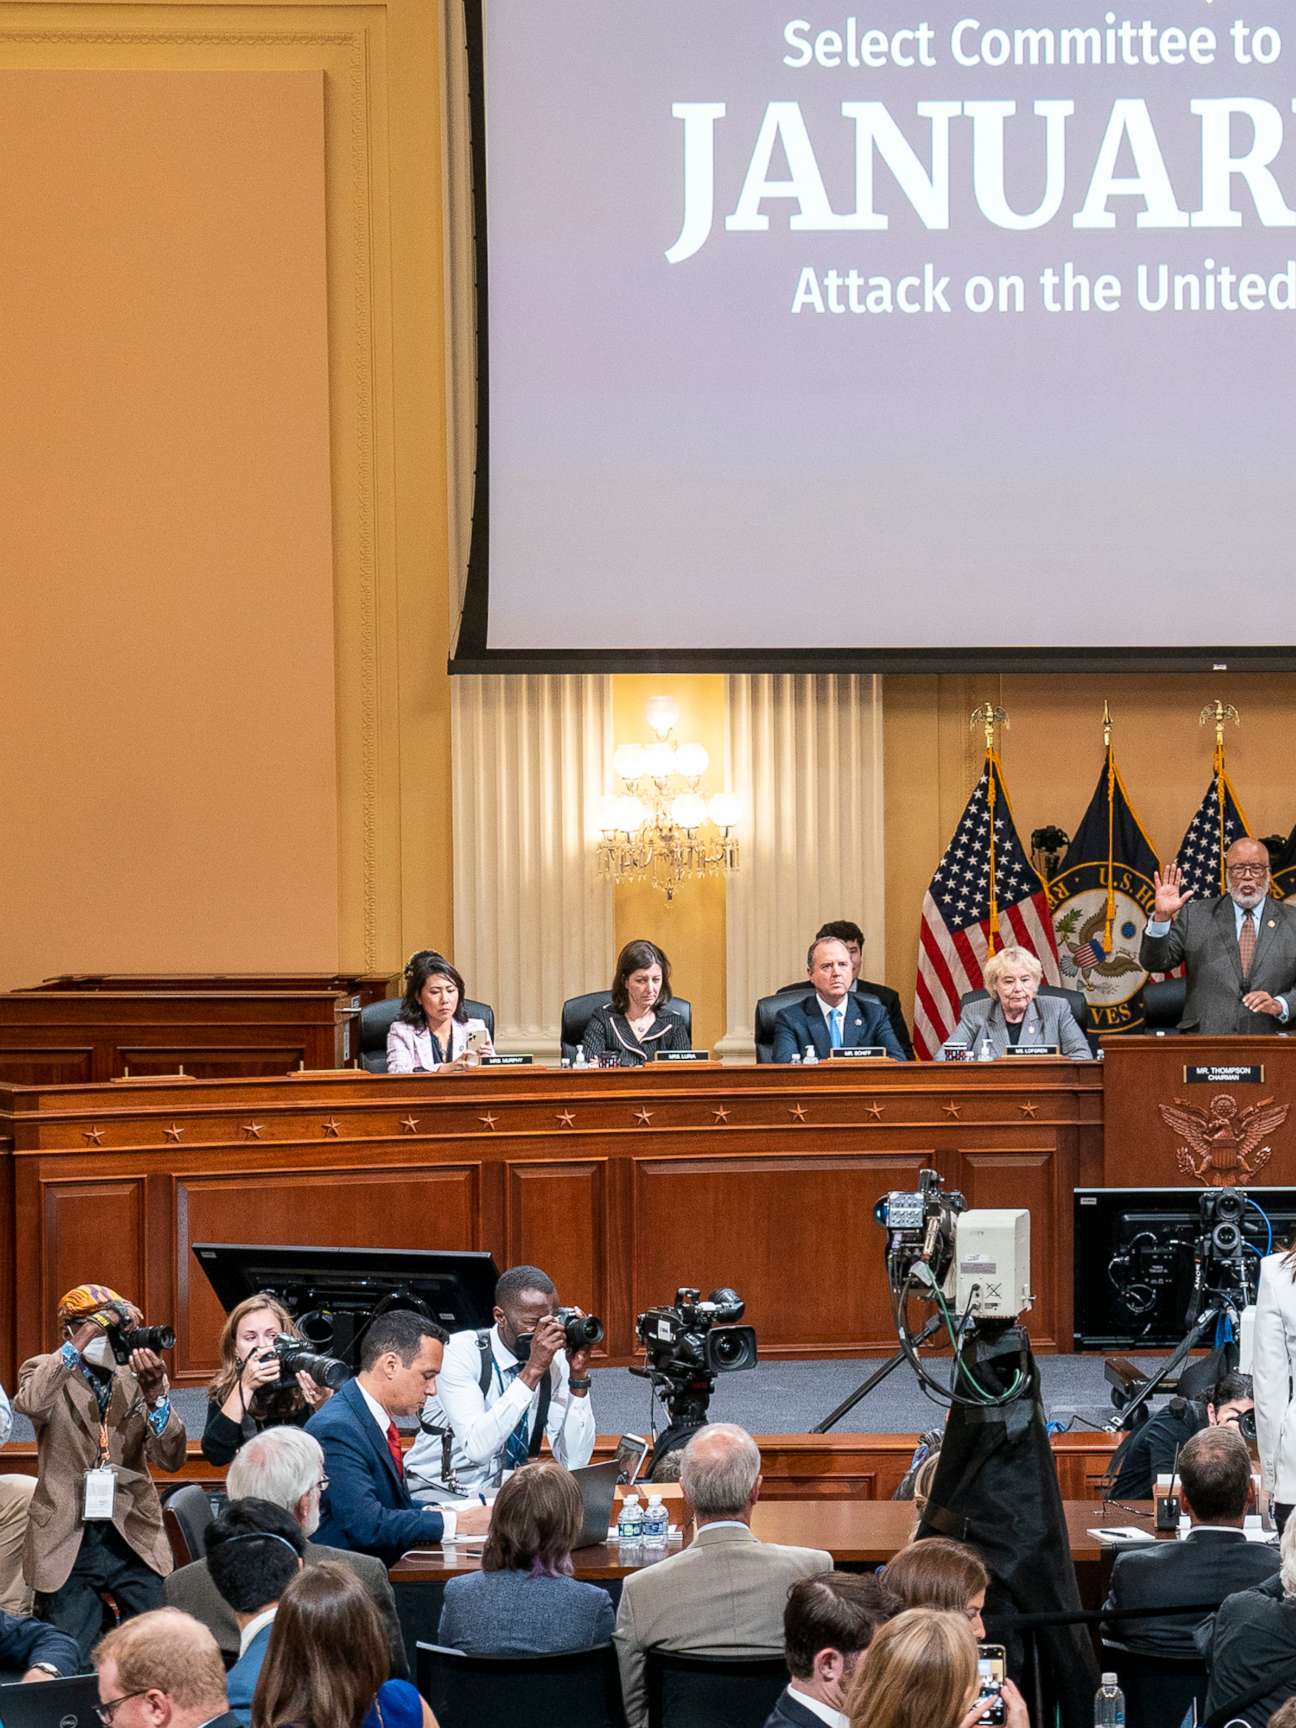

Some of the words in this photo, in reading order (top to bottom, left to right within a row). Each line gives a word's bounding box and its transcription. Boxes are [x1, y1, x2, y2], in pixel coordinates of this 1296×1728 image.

[783, 18, 936, 68] Select
[951, 12, 1216, 66] Committee
[1230, 20, 1281, 64] to
[791, 264, 950, 314] Attack
[965, 276, 1025, 313] on
[1040, 262, 1121, 311] the
[1137, 258, 1296, 311] United
